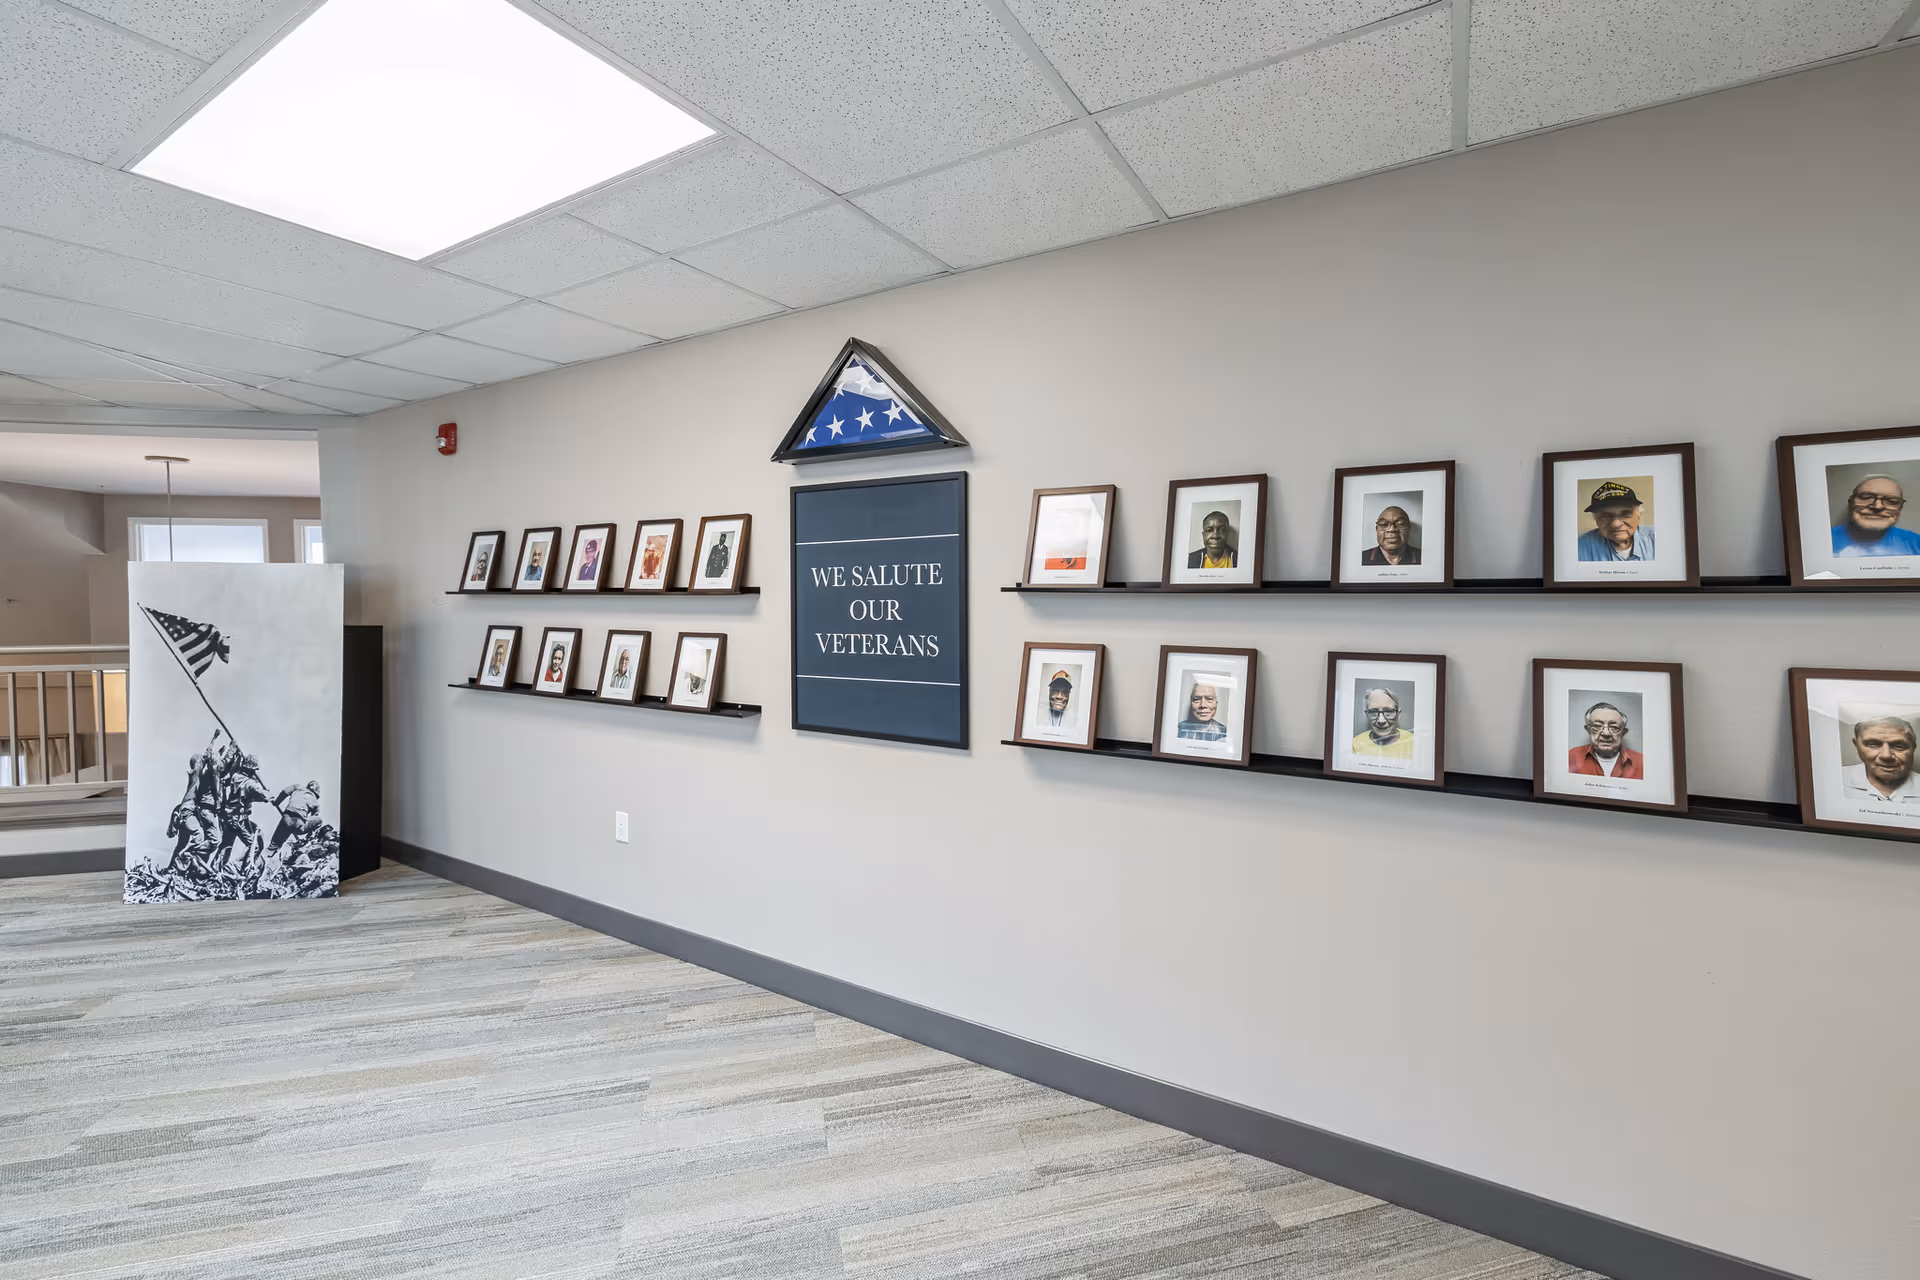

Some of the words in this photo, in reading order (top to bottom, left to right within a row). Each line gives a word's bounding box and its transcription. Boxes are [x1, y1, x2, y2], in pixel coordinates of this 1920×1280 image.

[811, 566, 846, 588] WE
[851, 562, 943, 588] SALUTE
[849, 599, 903, 621] OUR
[815, 632, 940, 658] VETERANS
